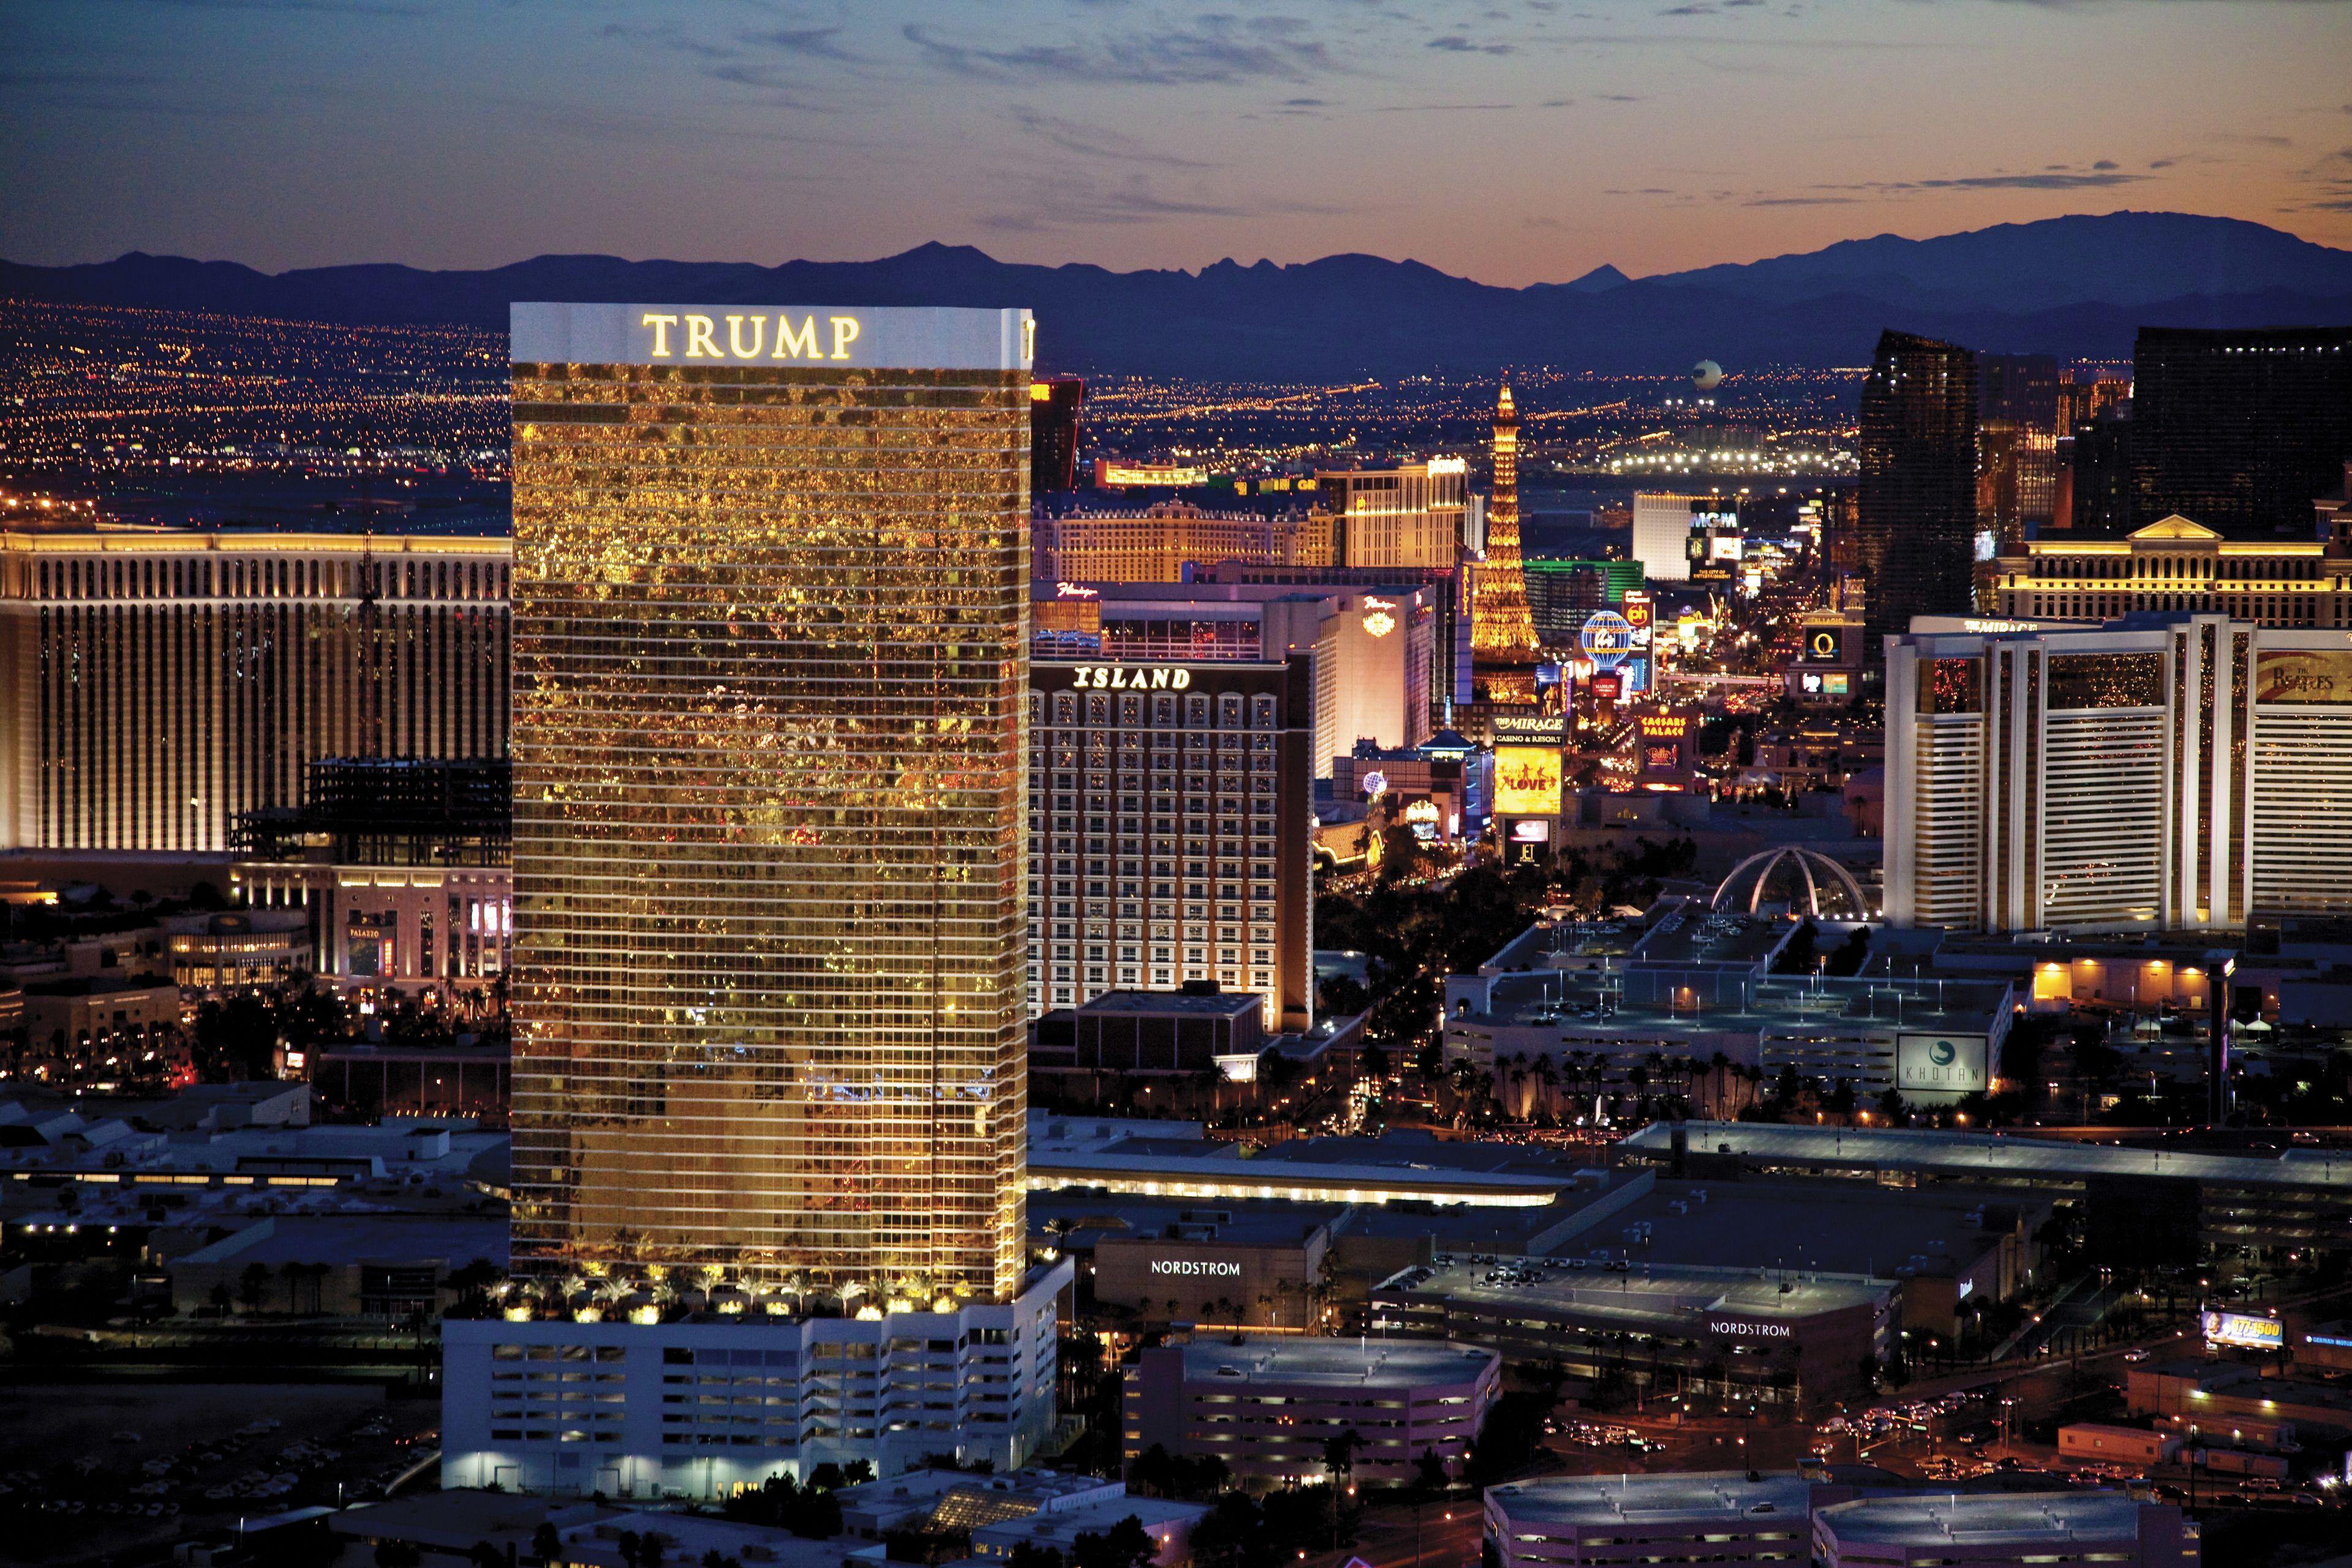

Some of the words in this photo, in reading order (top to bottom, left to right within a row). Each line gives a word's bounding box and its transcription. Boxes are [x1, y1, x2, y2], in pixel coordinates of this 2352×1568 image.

[643, 313, 860, 360] TRUMP
[1689, 512, 1738, 528] MGM
[1073, 666, 1190, 689] ISLAND
[1506, 718, 1564, 731] MIRAGE
[1642, 717, 1686, 726] CAESARS
[1643, 726, 1684, 736] PALACE
[1510, 779, 1546, 790] LOVE
[1520, 844, 1535, 860] JET
[350, 929, 379, 938] PALAZZO
[1906, 1067, 1978, 1081] KHOTAN
[1152, 1261, 1240, 1276] NORDSTROM
[1711, 1322, 1790, 1336] NORDSTROM
